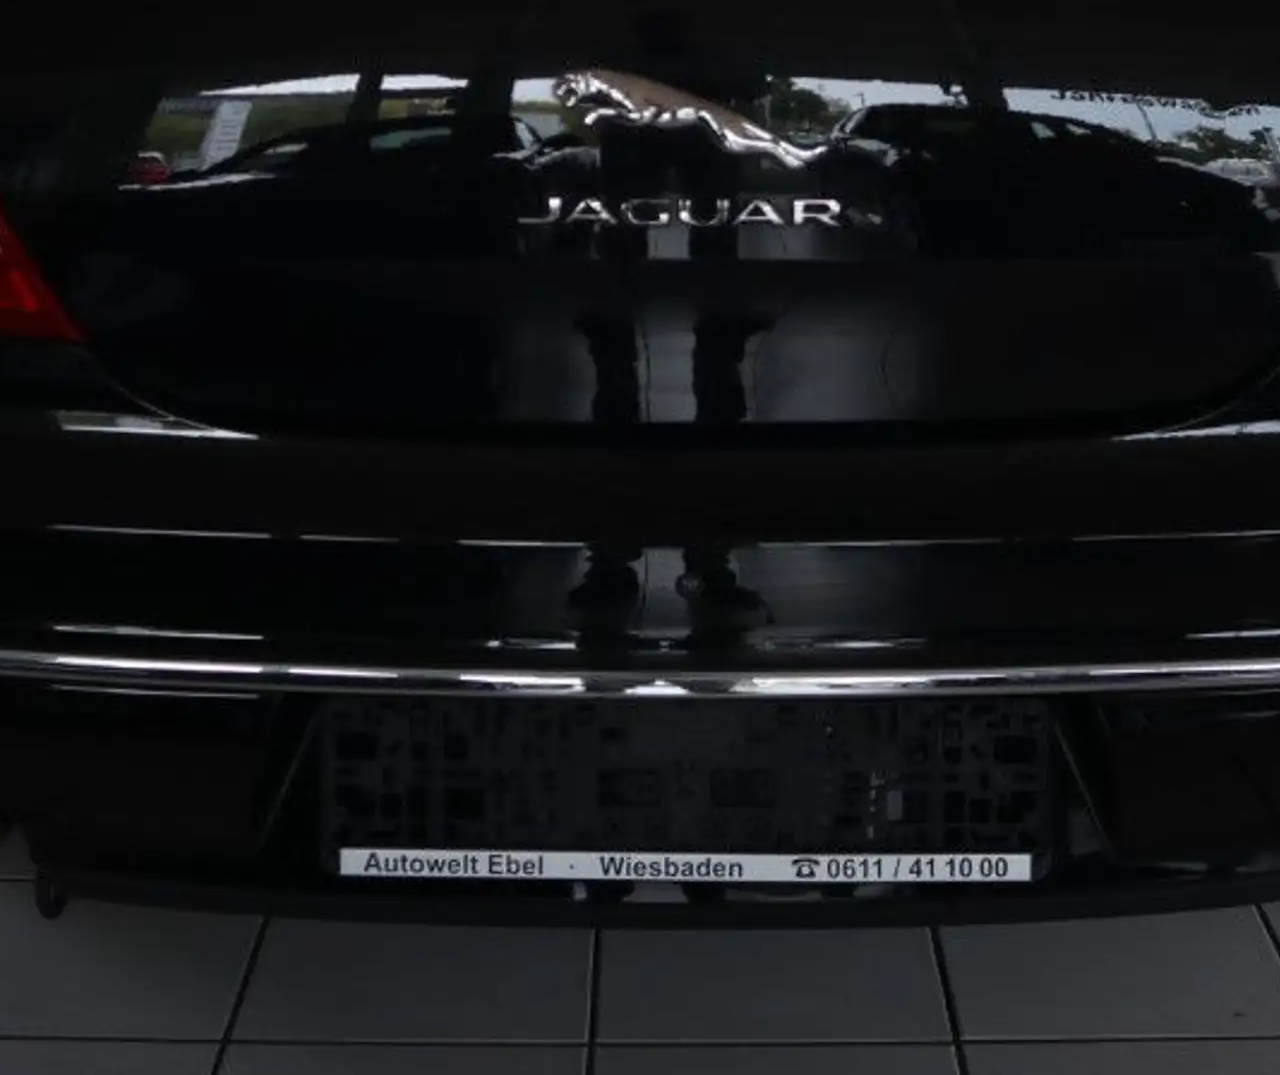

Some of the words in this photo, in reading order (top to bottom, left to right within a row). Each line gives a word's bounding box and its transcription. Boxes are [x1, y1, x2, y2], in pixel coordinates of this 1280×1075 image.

[517, 196, 842, 225] JAGUAR
[362, 851, 480, 876] Autowelt
[487, 853, 545, 876] Ebel
[598, 855, 745, 881] Wiesbaden
[826, 857, 883, 879] 0611
[908, 857, 936, 878] 41
